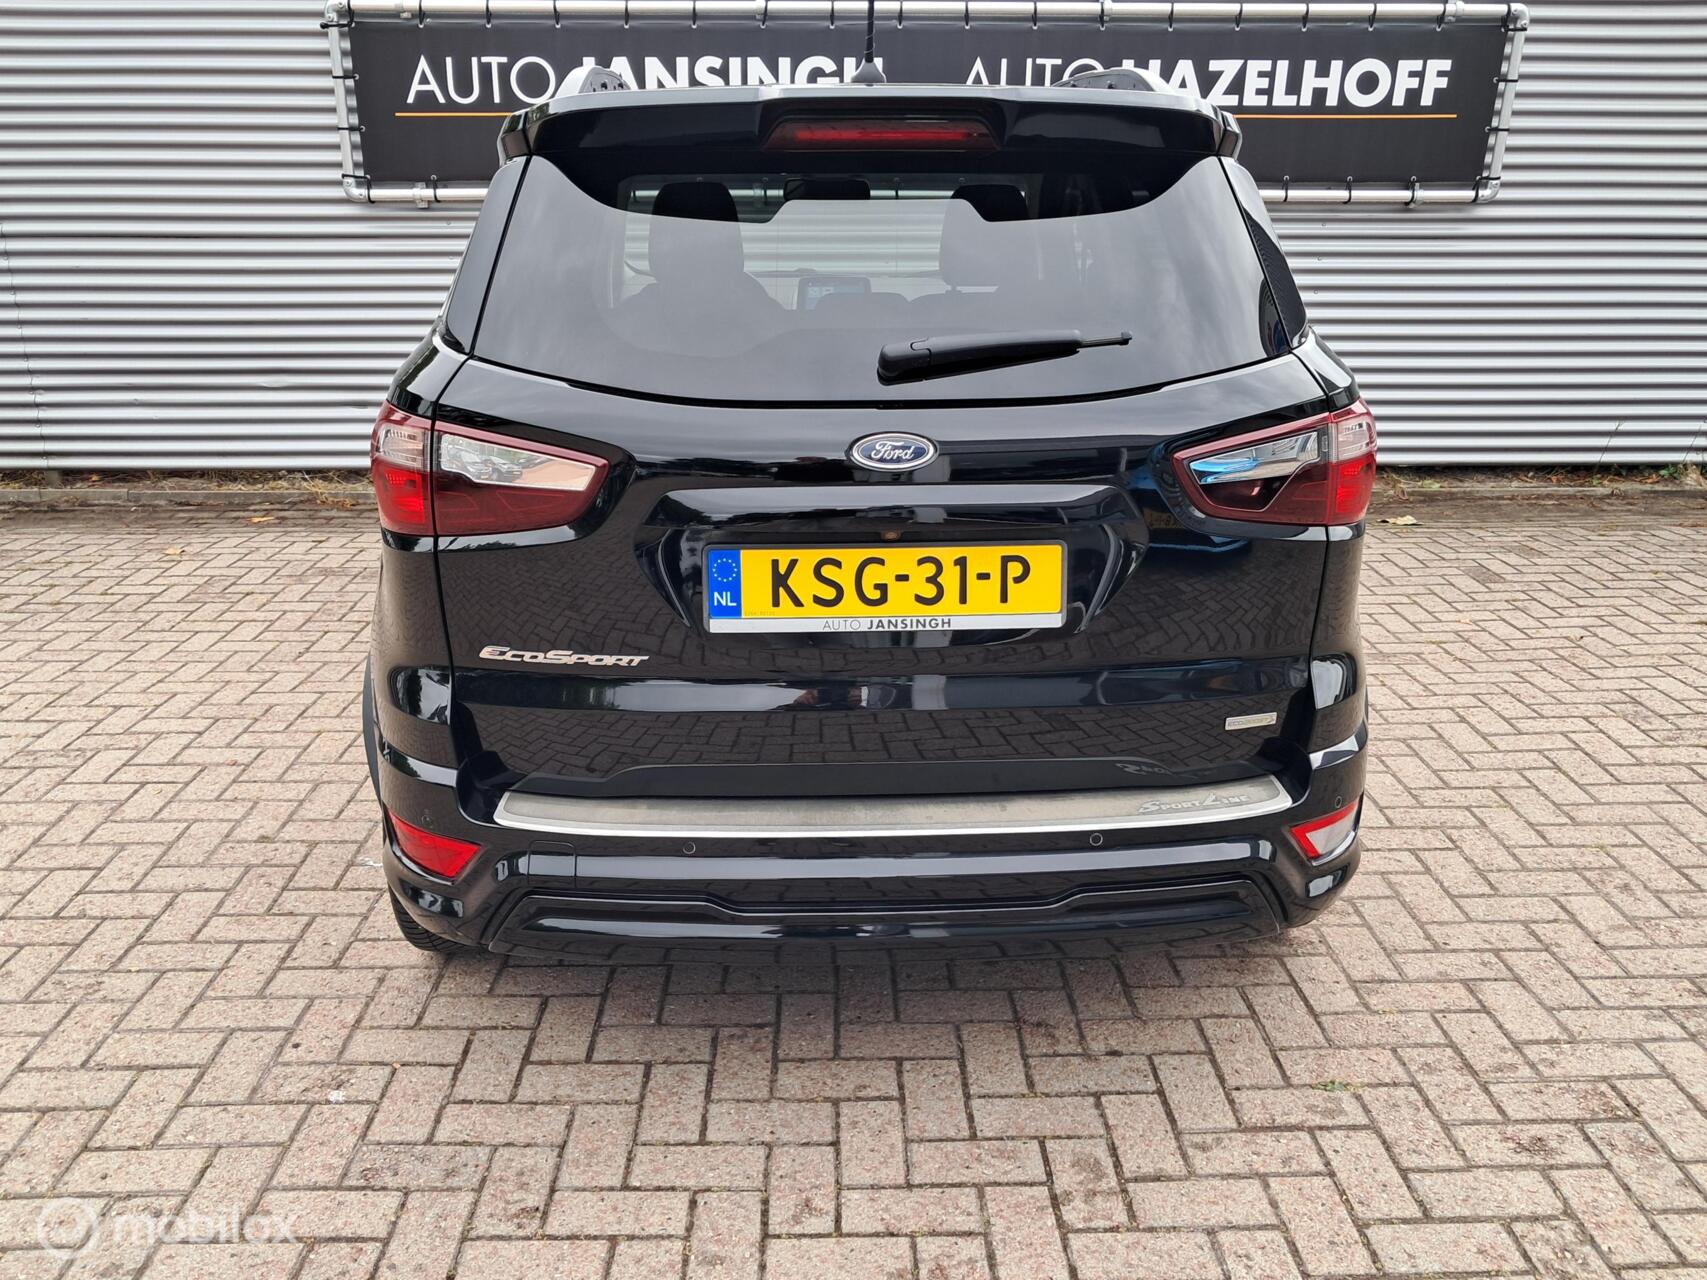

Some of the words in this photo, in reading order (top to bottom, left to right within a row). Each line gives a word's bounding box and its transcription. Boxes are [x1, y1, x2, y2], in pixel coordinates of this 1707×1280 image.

[406, 54, 556, 104] AUTO
[871, 440, 915, 460] Ford
[771, 555, 1031, 608] KSG-31-P
[713, 591, 737, 606] NL
[823, 619, 861, 631] AUTO
[867, 618, 952, 630] JANSINGH
